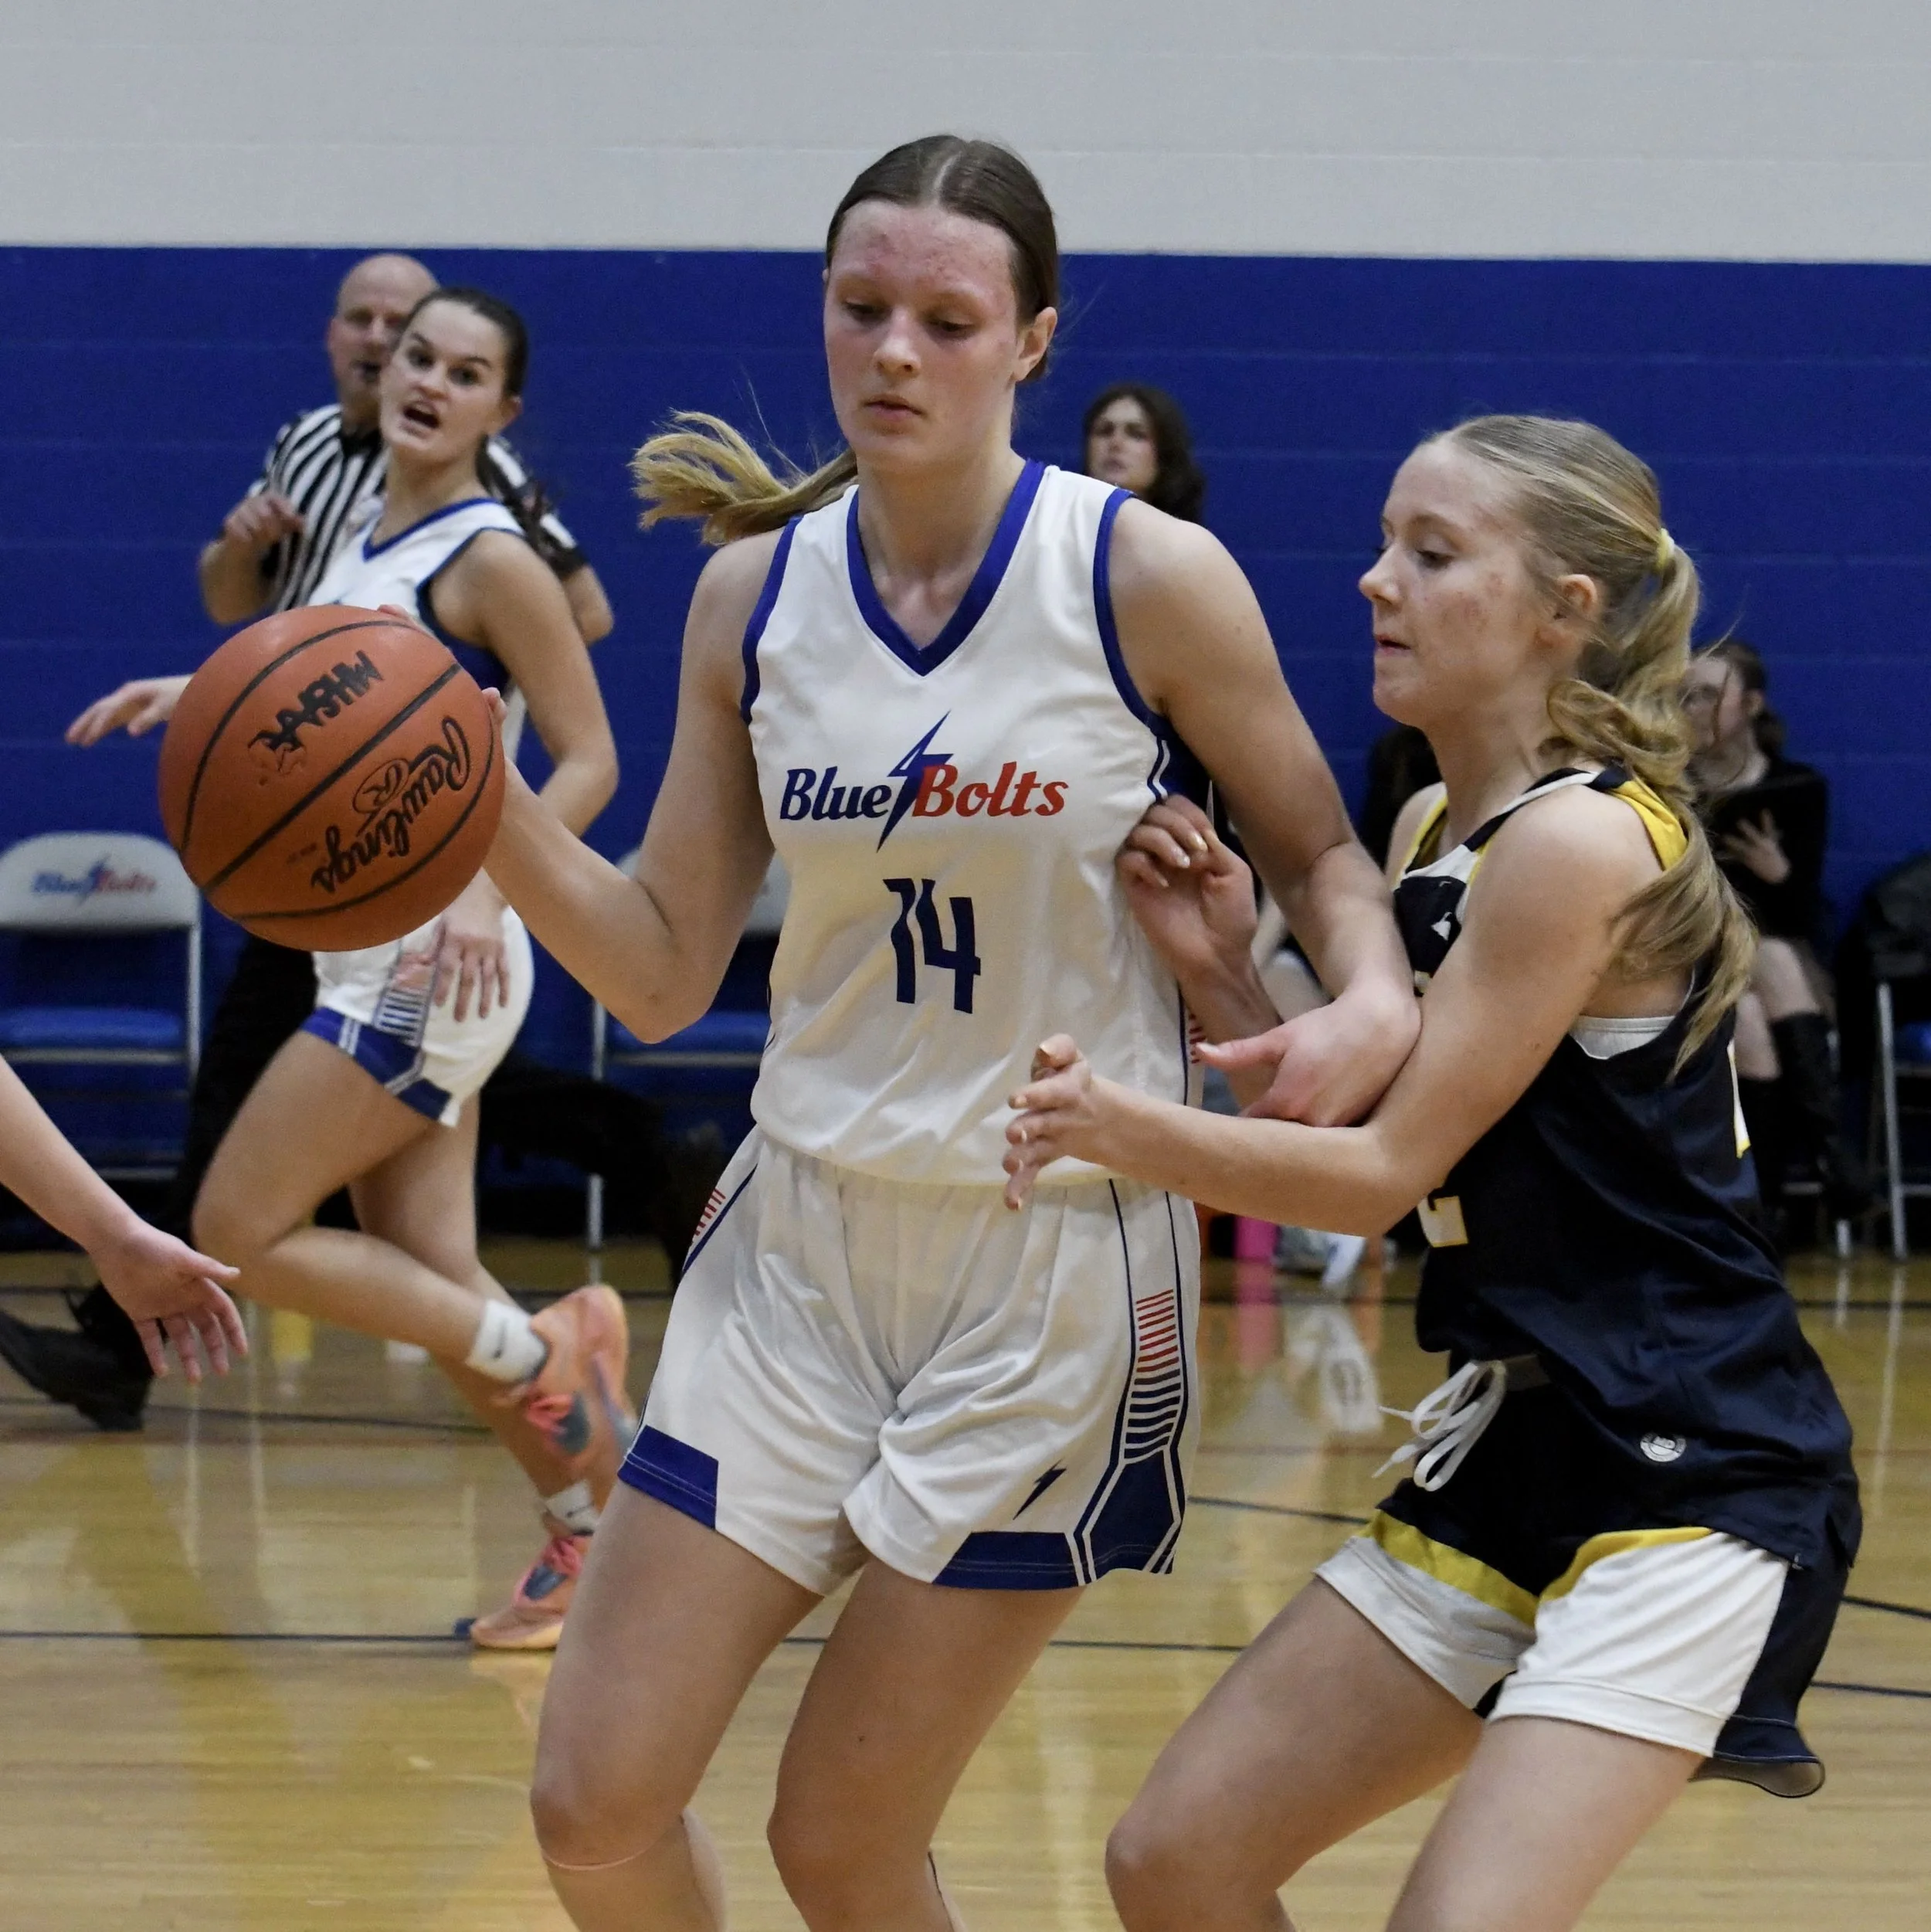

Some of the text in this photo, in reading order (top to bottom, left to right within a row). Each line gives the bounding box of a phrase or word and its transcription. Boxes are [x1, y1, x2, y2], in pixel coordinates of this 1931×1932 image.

[311, 715, 470, 894] Rawlings
[361, 761, 406, 808] R
[780, 761, 1069, 821] Blue Bolts
[883, 878, 981, 1014] 14
